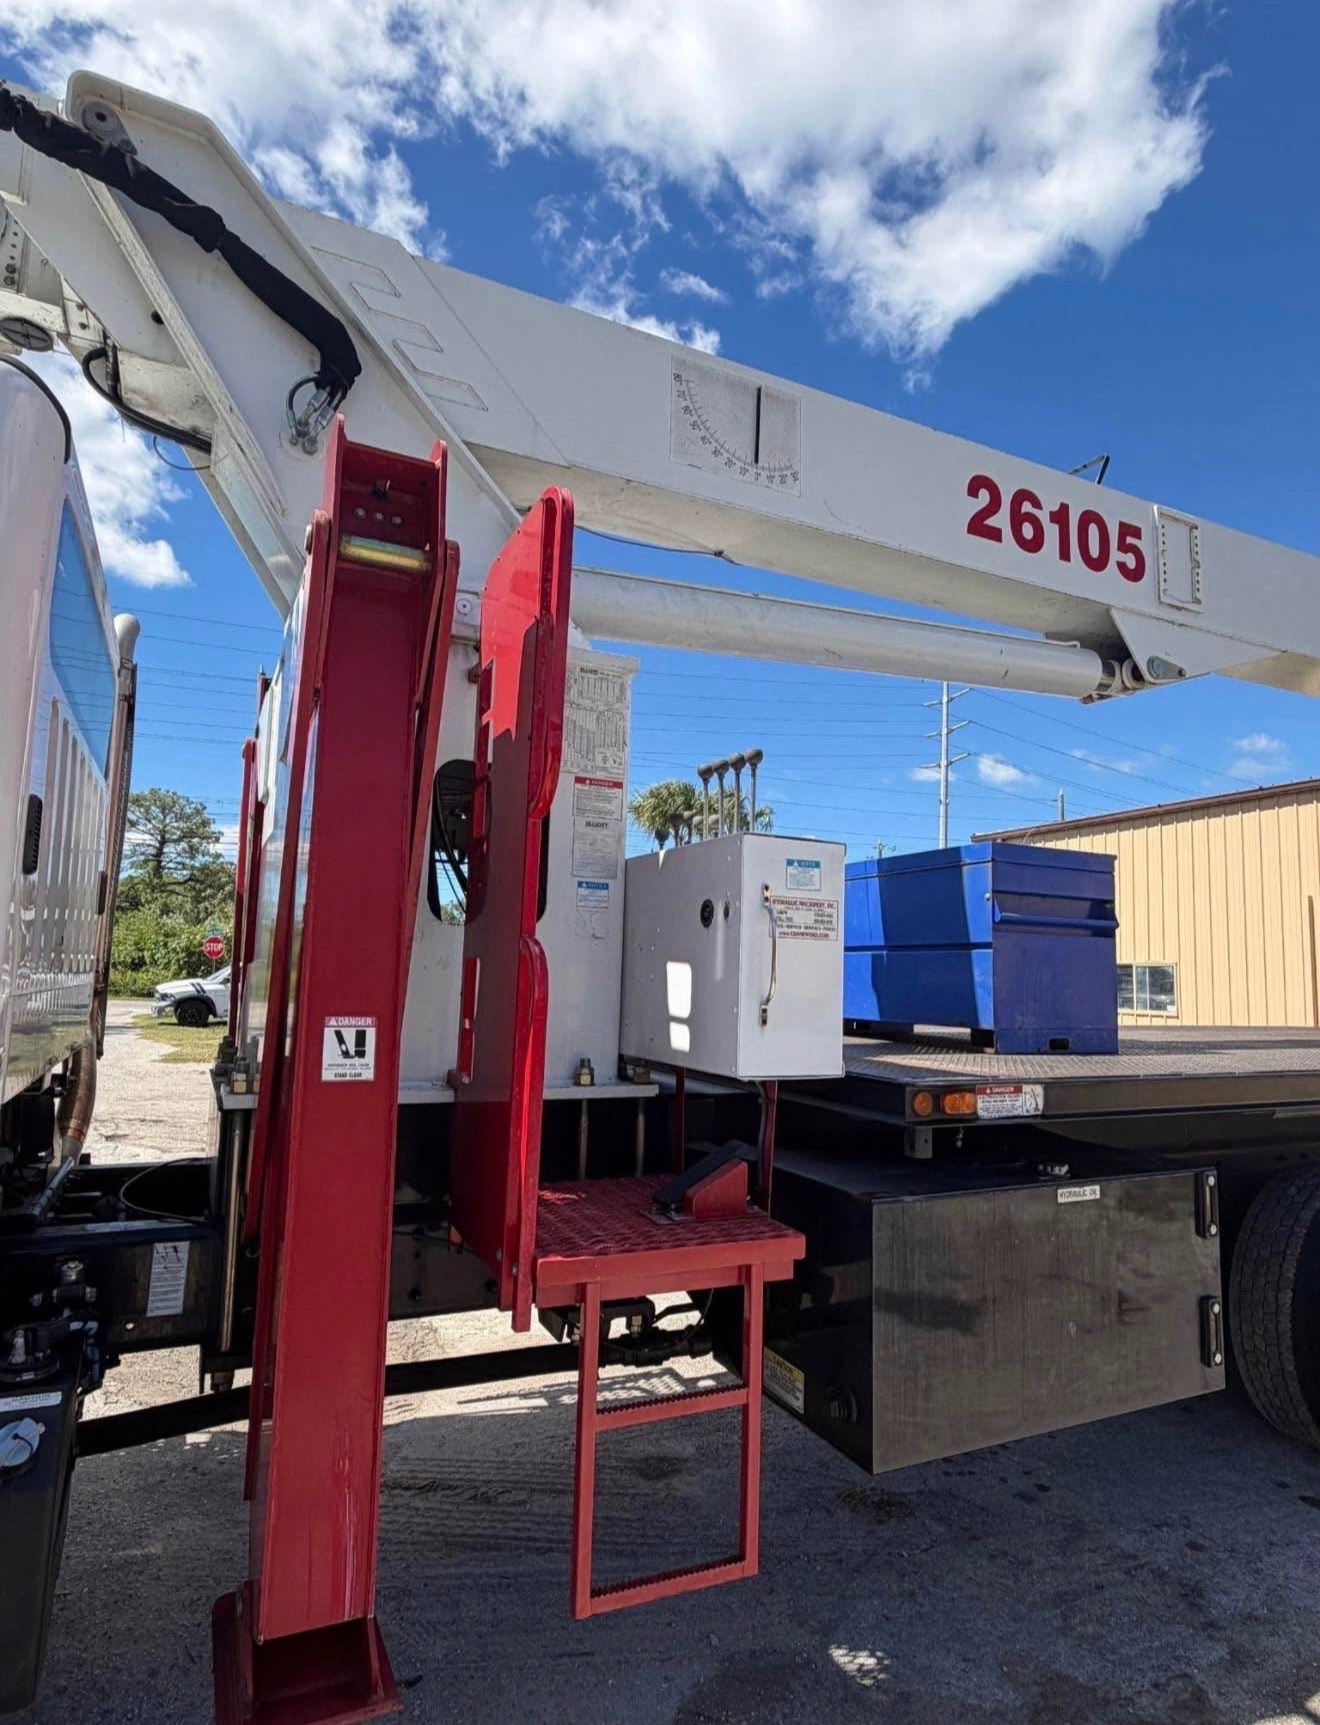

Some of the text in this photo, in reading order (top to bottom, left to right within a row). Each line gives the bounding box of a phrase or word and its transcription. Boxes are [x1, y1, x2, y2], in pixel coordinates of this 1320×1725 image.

[967, 474, 1146, 583] 26105
[206, 943, 223, 951] STOP
[338, 1017, 372, 1026] DANGER
[1060, 1189, 1088, 1199] HYDRAULIC
